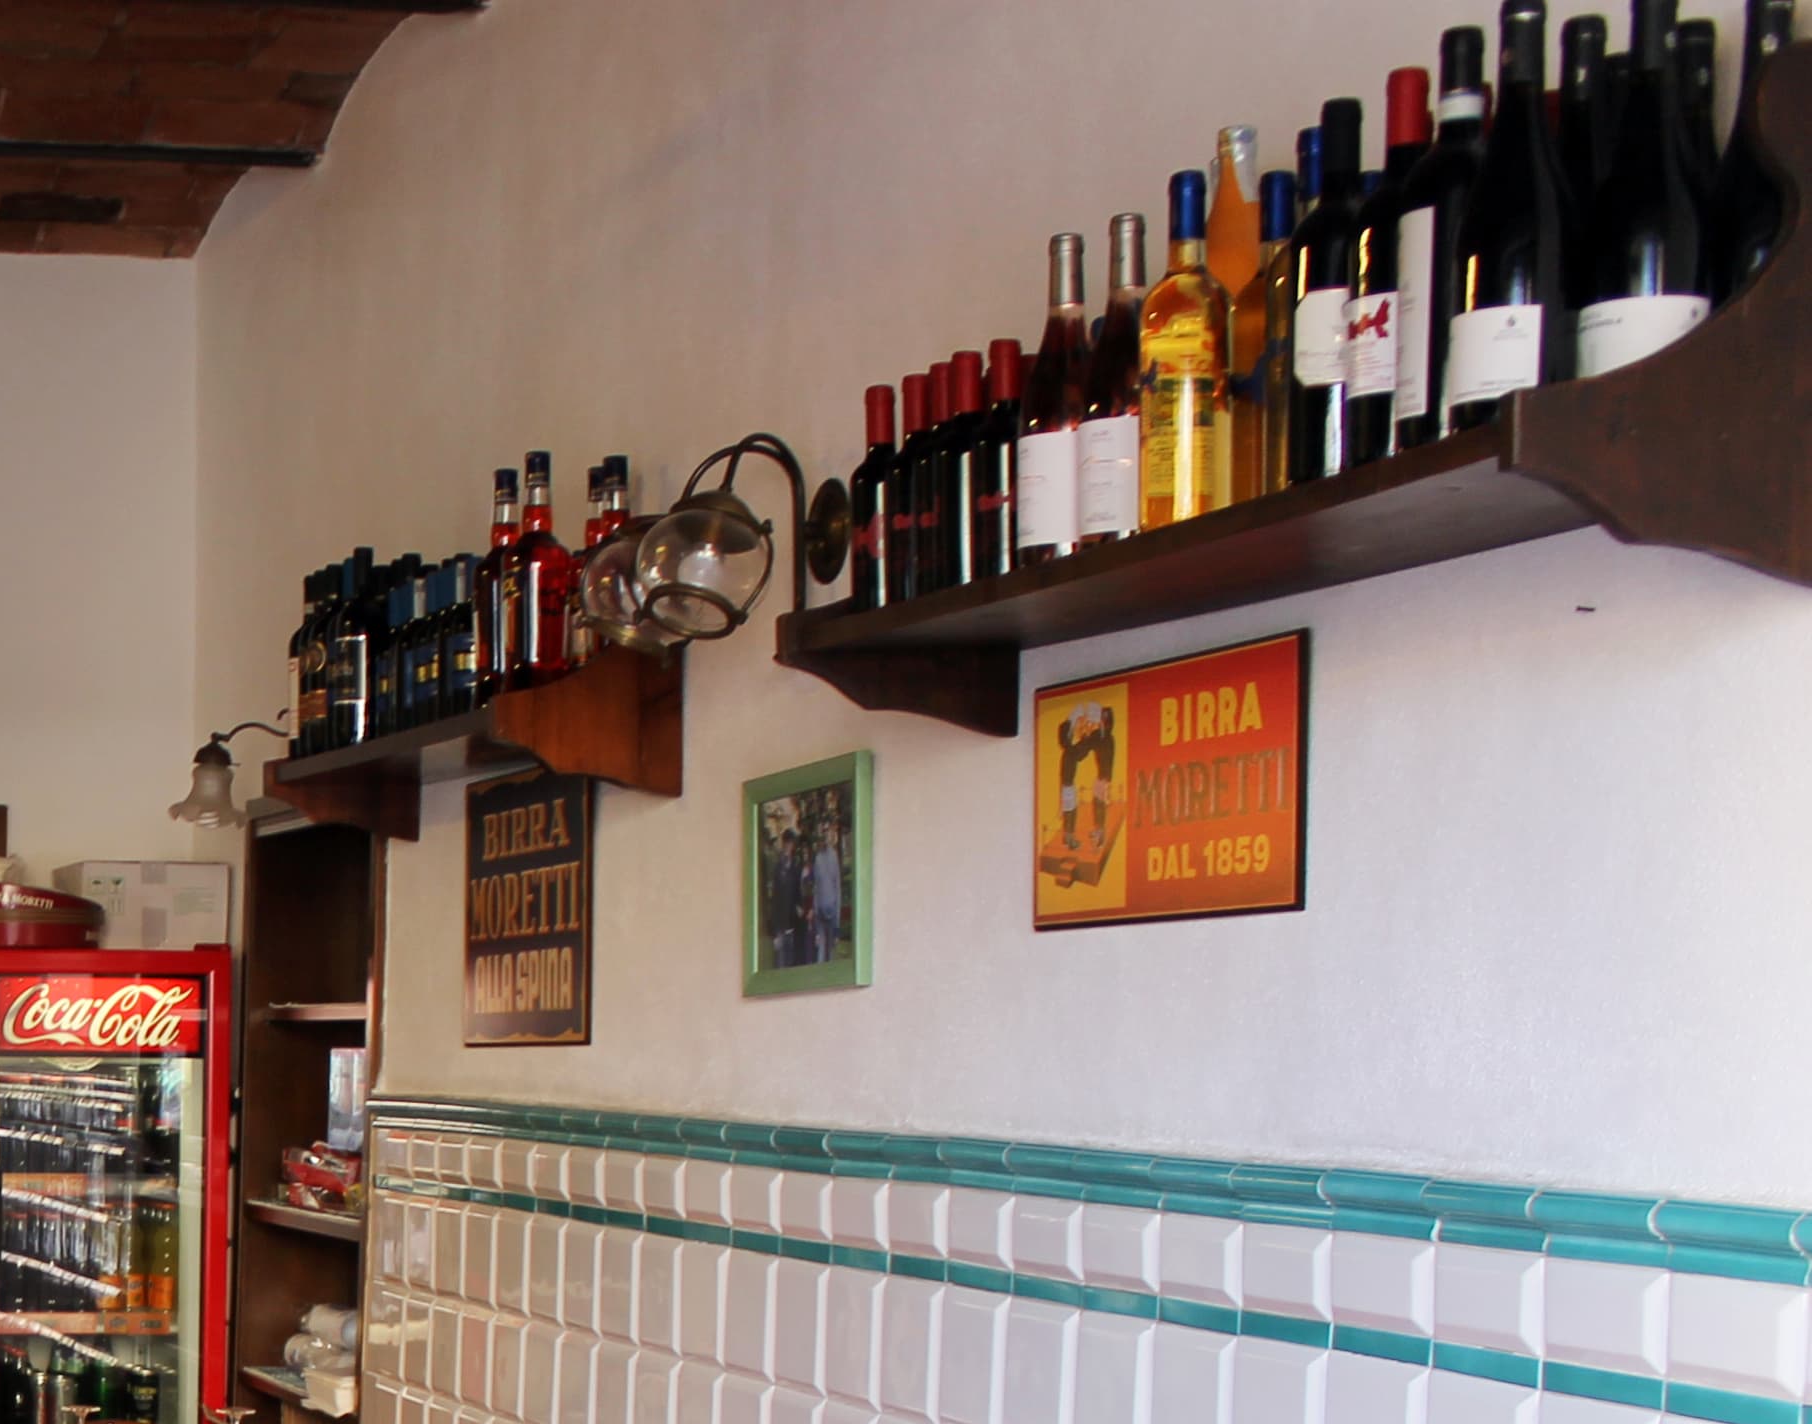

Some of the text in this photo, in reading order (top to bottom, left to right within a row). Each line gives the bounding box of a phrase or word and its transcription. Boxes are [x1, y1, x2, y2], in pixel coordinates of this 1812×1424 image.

[1158, 681, 1264, 747] BIRRA
[1134, 745, 1293, 829] MORETTI
[481, 798, 570, 862] BIRRA
[1146, 833, 1271, 882] DAL 1859
[12, 893, 55, 911] MORETTI
[469, 860, 581, 942] MORETTI
[474, 946, 574, 1014] ALLA SPINA
[2, 982, 194, 1048] Coca-Cola
